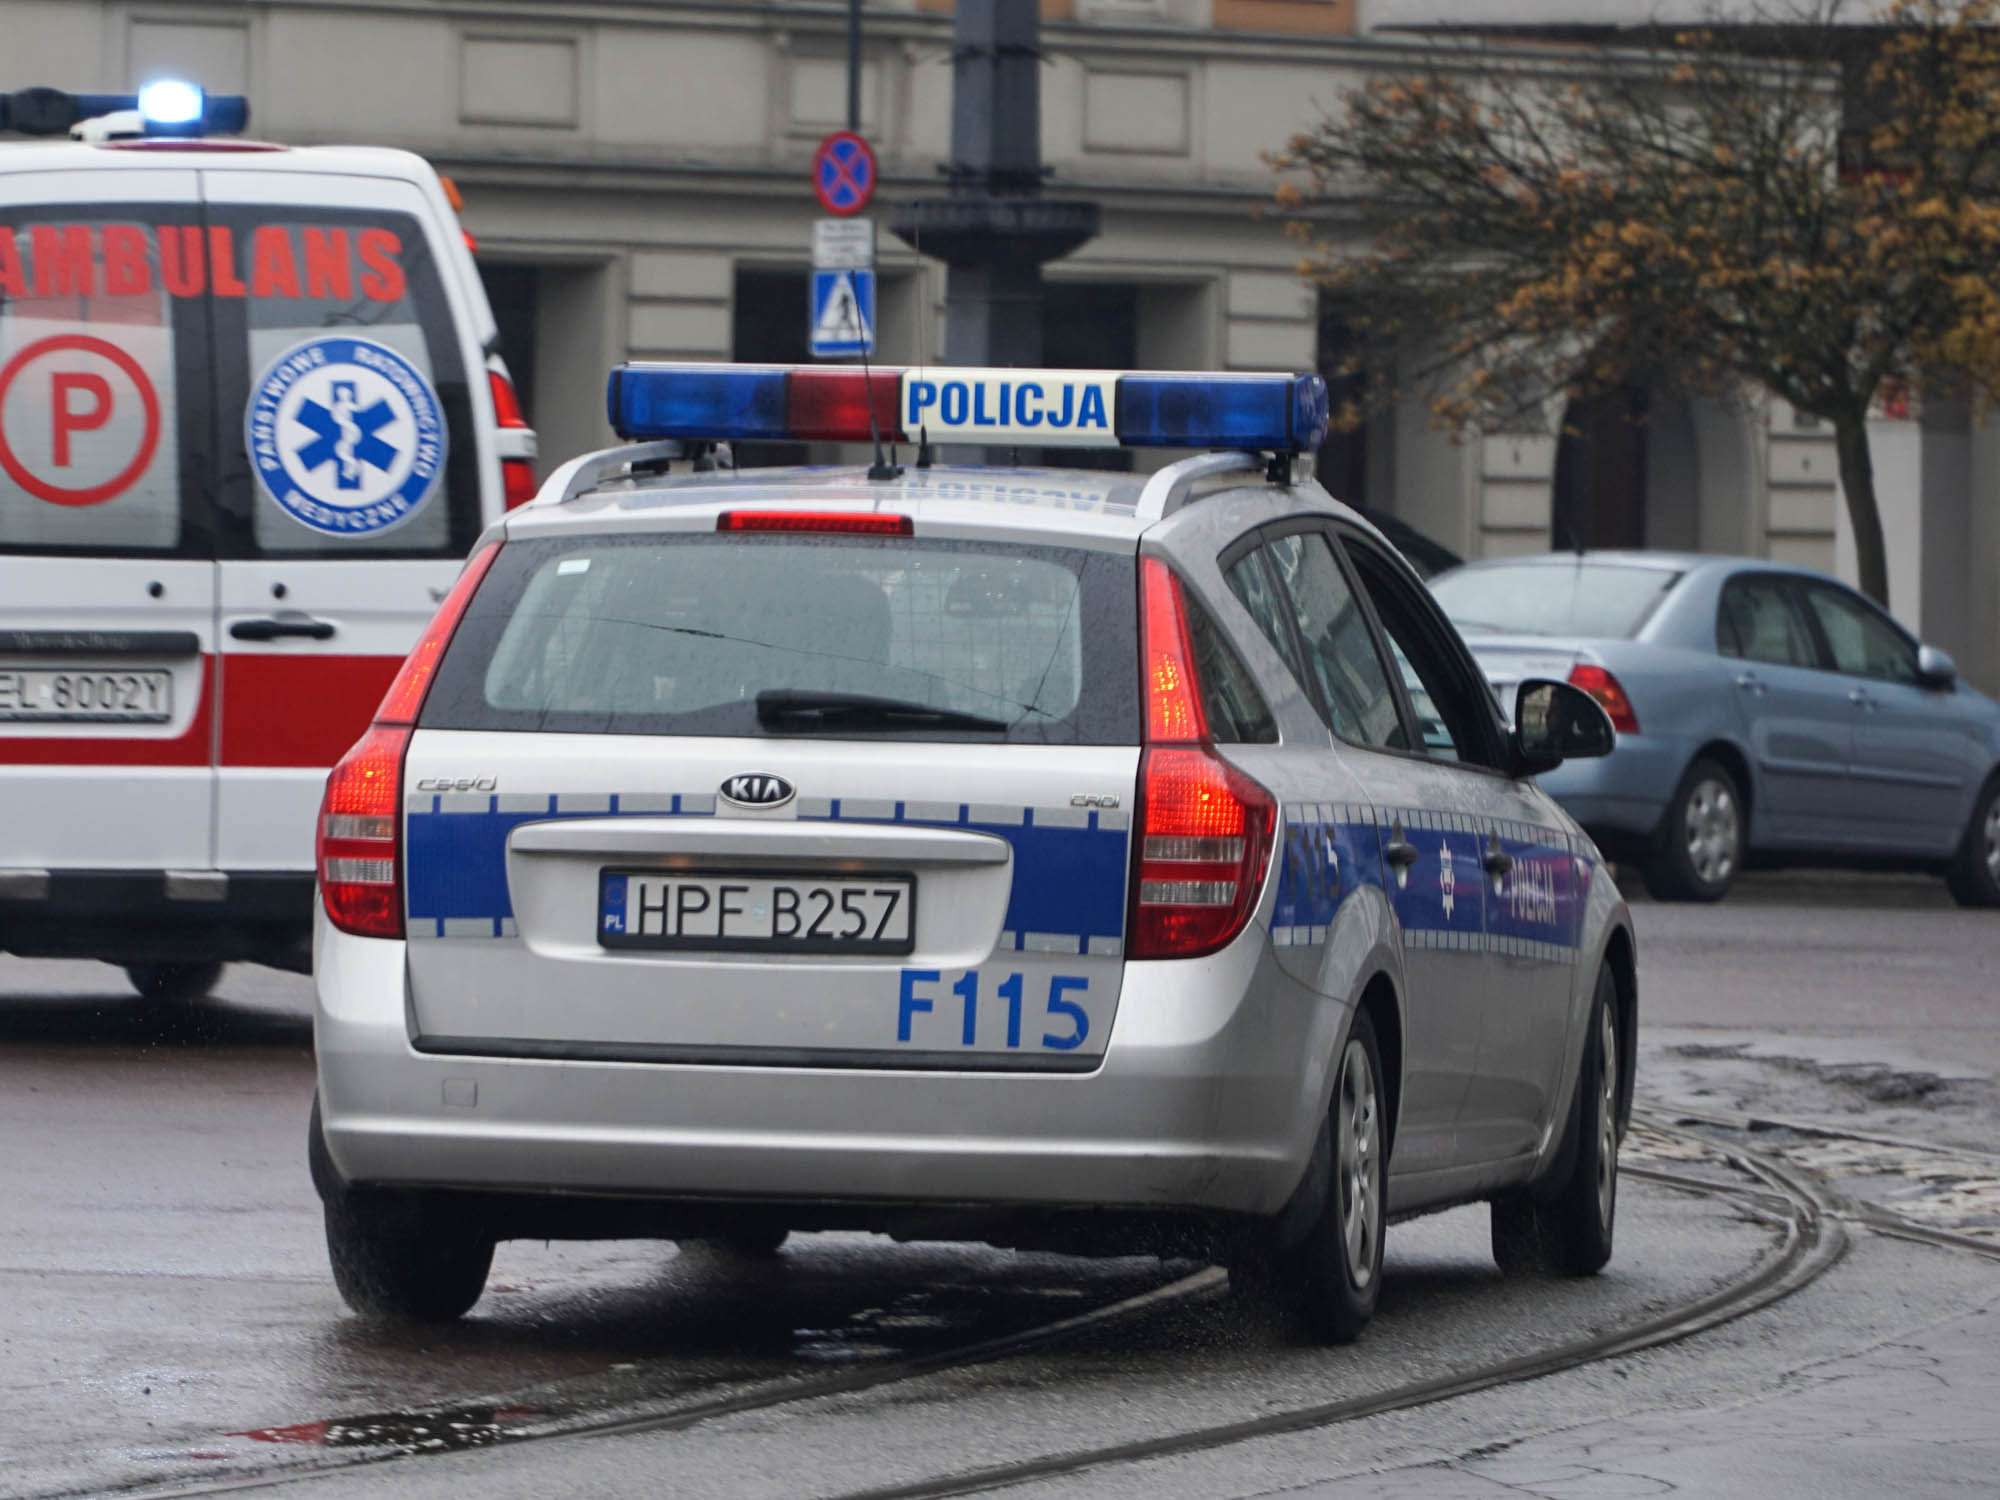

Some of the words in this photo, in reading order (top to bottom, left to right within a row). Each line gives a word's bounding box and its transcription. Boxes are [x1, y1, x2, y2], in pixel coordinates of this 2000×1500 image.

[0, 225, 406, 301] AMBULANS
[51, 372, 114, 467] P
[909, 381, 1108, 428] POLICJA
[53, 675, 164, 710] 8002Y
[730, 778, 781, 800] KIA
[605, 914, 624, 929] PL
[637, 883, 749, 937] HPF
[772, 886, 901, 940] B257
[897, 968, 1090, 1051] F115
